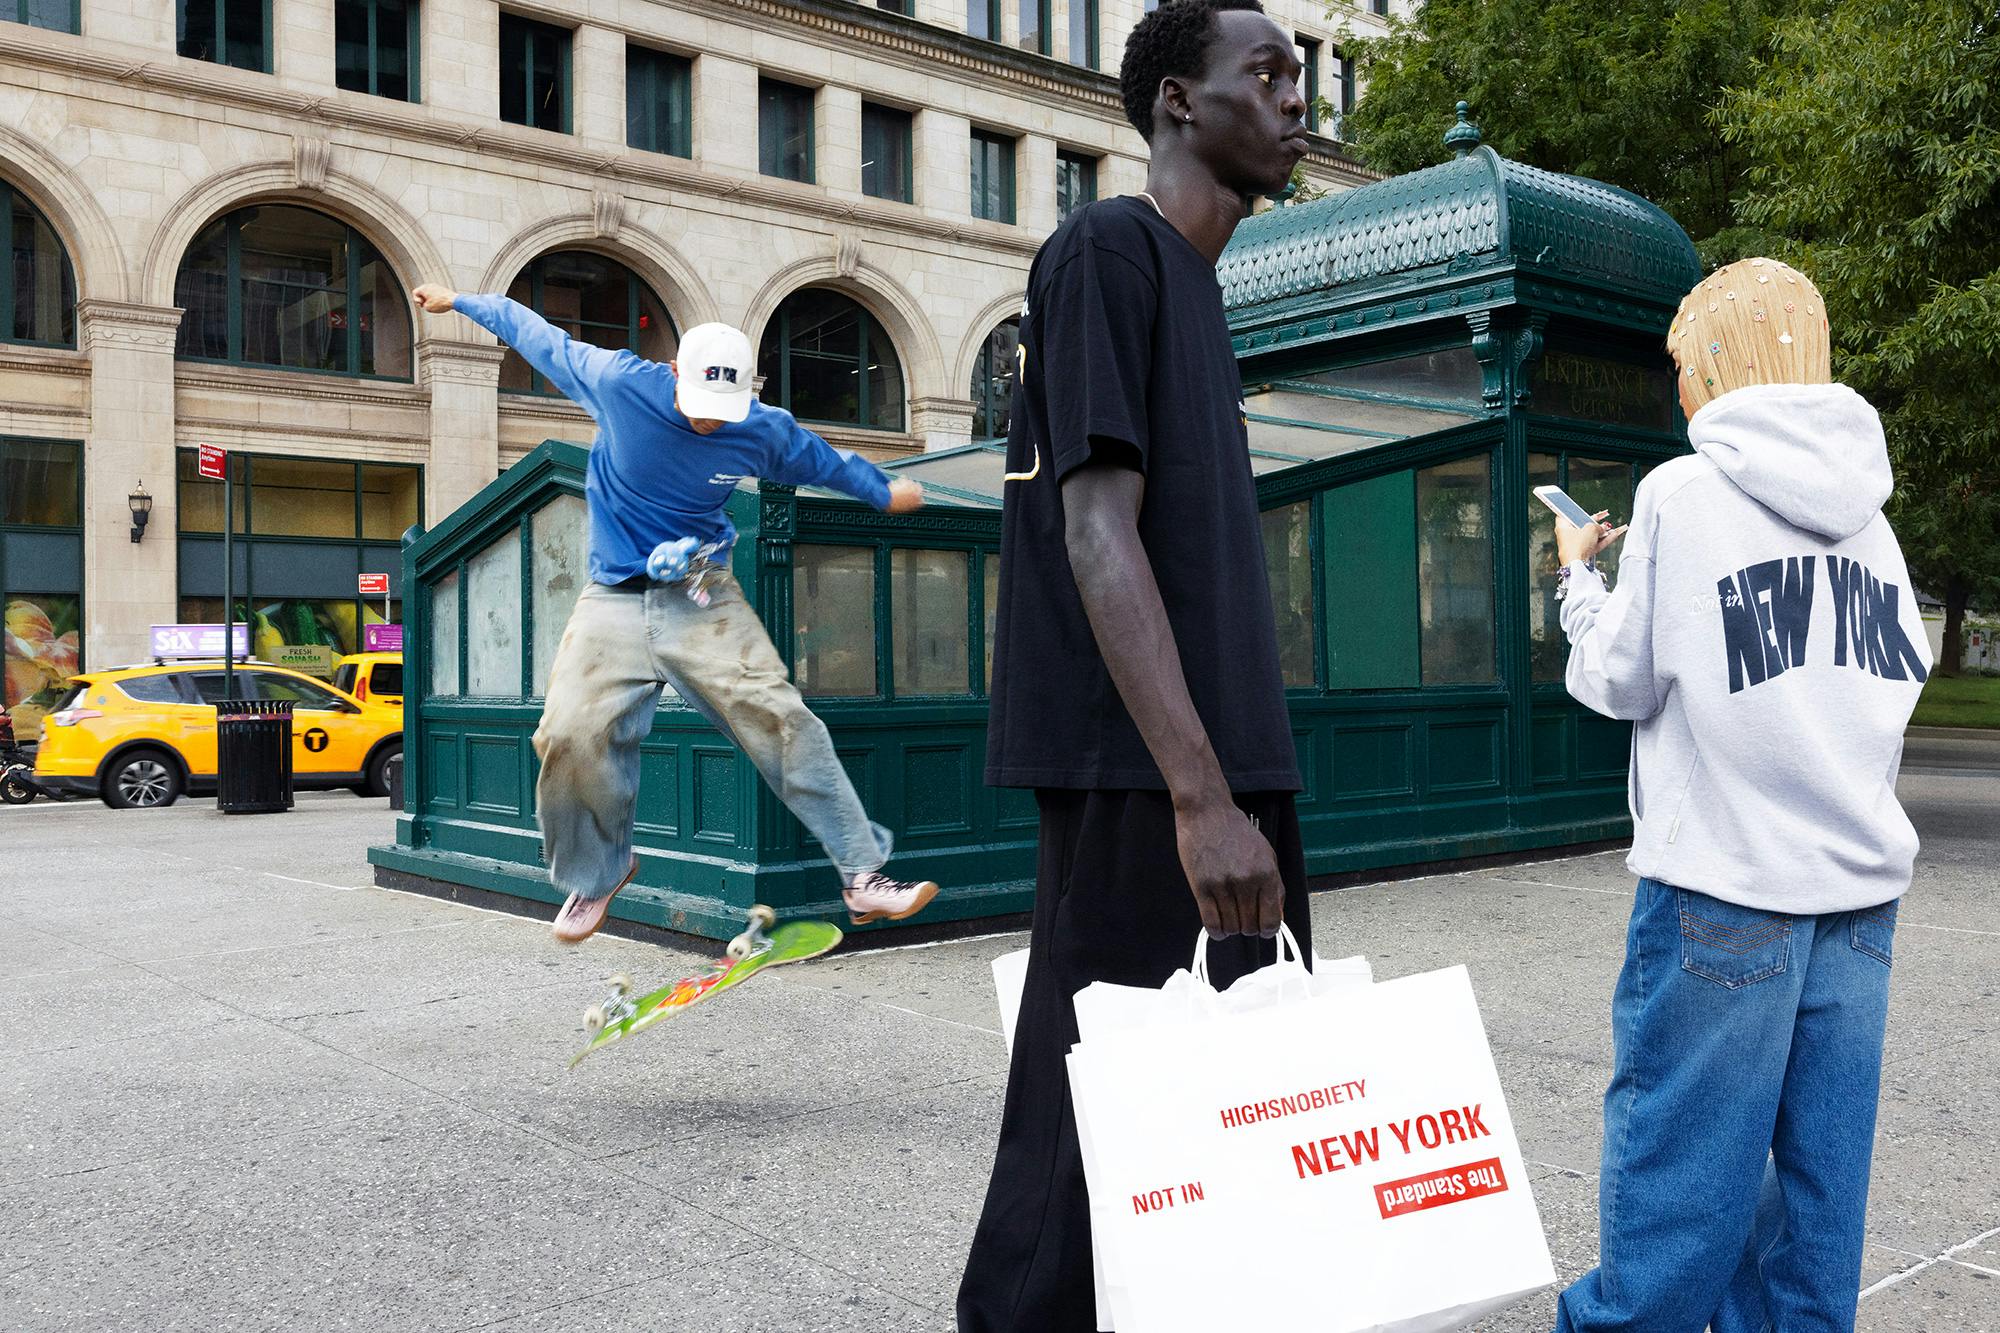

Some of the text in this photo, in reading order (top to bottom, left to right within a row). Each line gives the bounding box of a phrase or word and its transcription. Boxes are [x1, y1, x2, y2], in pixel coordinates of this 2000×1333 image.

[1544, 355, 1645, 397] ENTRANCE
[1688, 589, 1743, 616] Not in
[1717, 554, 1928, 694] NEW YORK
[281, 655, 321, 664] SQUASH
[289, 648, 313, 656] FRESH
[1220, 1079, 1367, 1128] HIGHSNOBIETY
[1291, 1103, 1492, 1179] NEW YORK
[1131, 1181, 1205, 1215] NOT IN
[1382, 1164, 1502, 1212] The Standard
